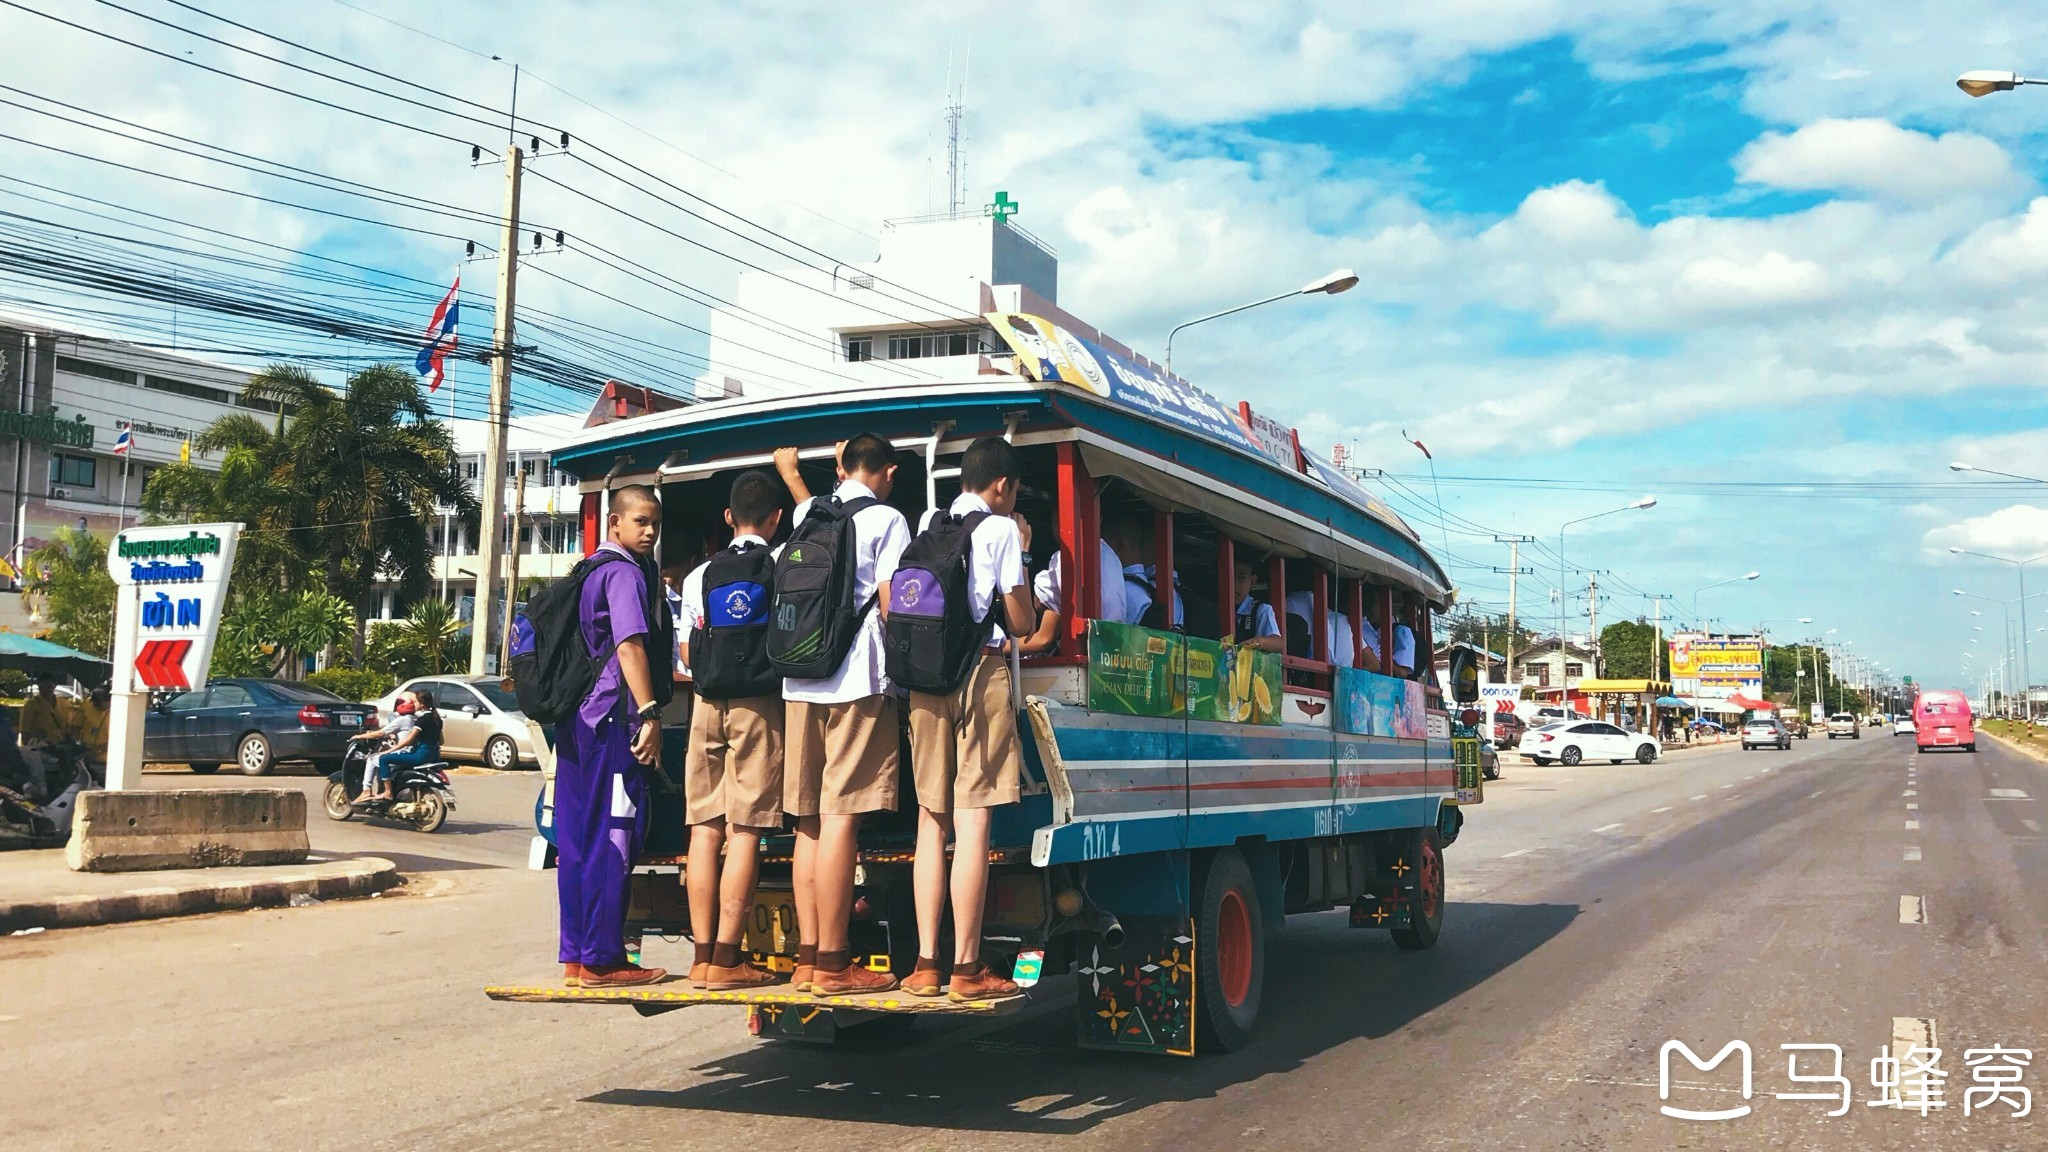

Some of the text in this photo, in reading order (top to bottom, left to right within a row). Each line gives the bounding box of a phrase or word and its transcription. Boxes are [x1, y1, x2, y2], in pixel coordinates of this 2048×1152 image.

[118, 531, 221, 560] โรงพยาบาลสุโขทัย
[777, 603, 796, 631] 49
[1502, 688, 1518, 696] OUT
